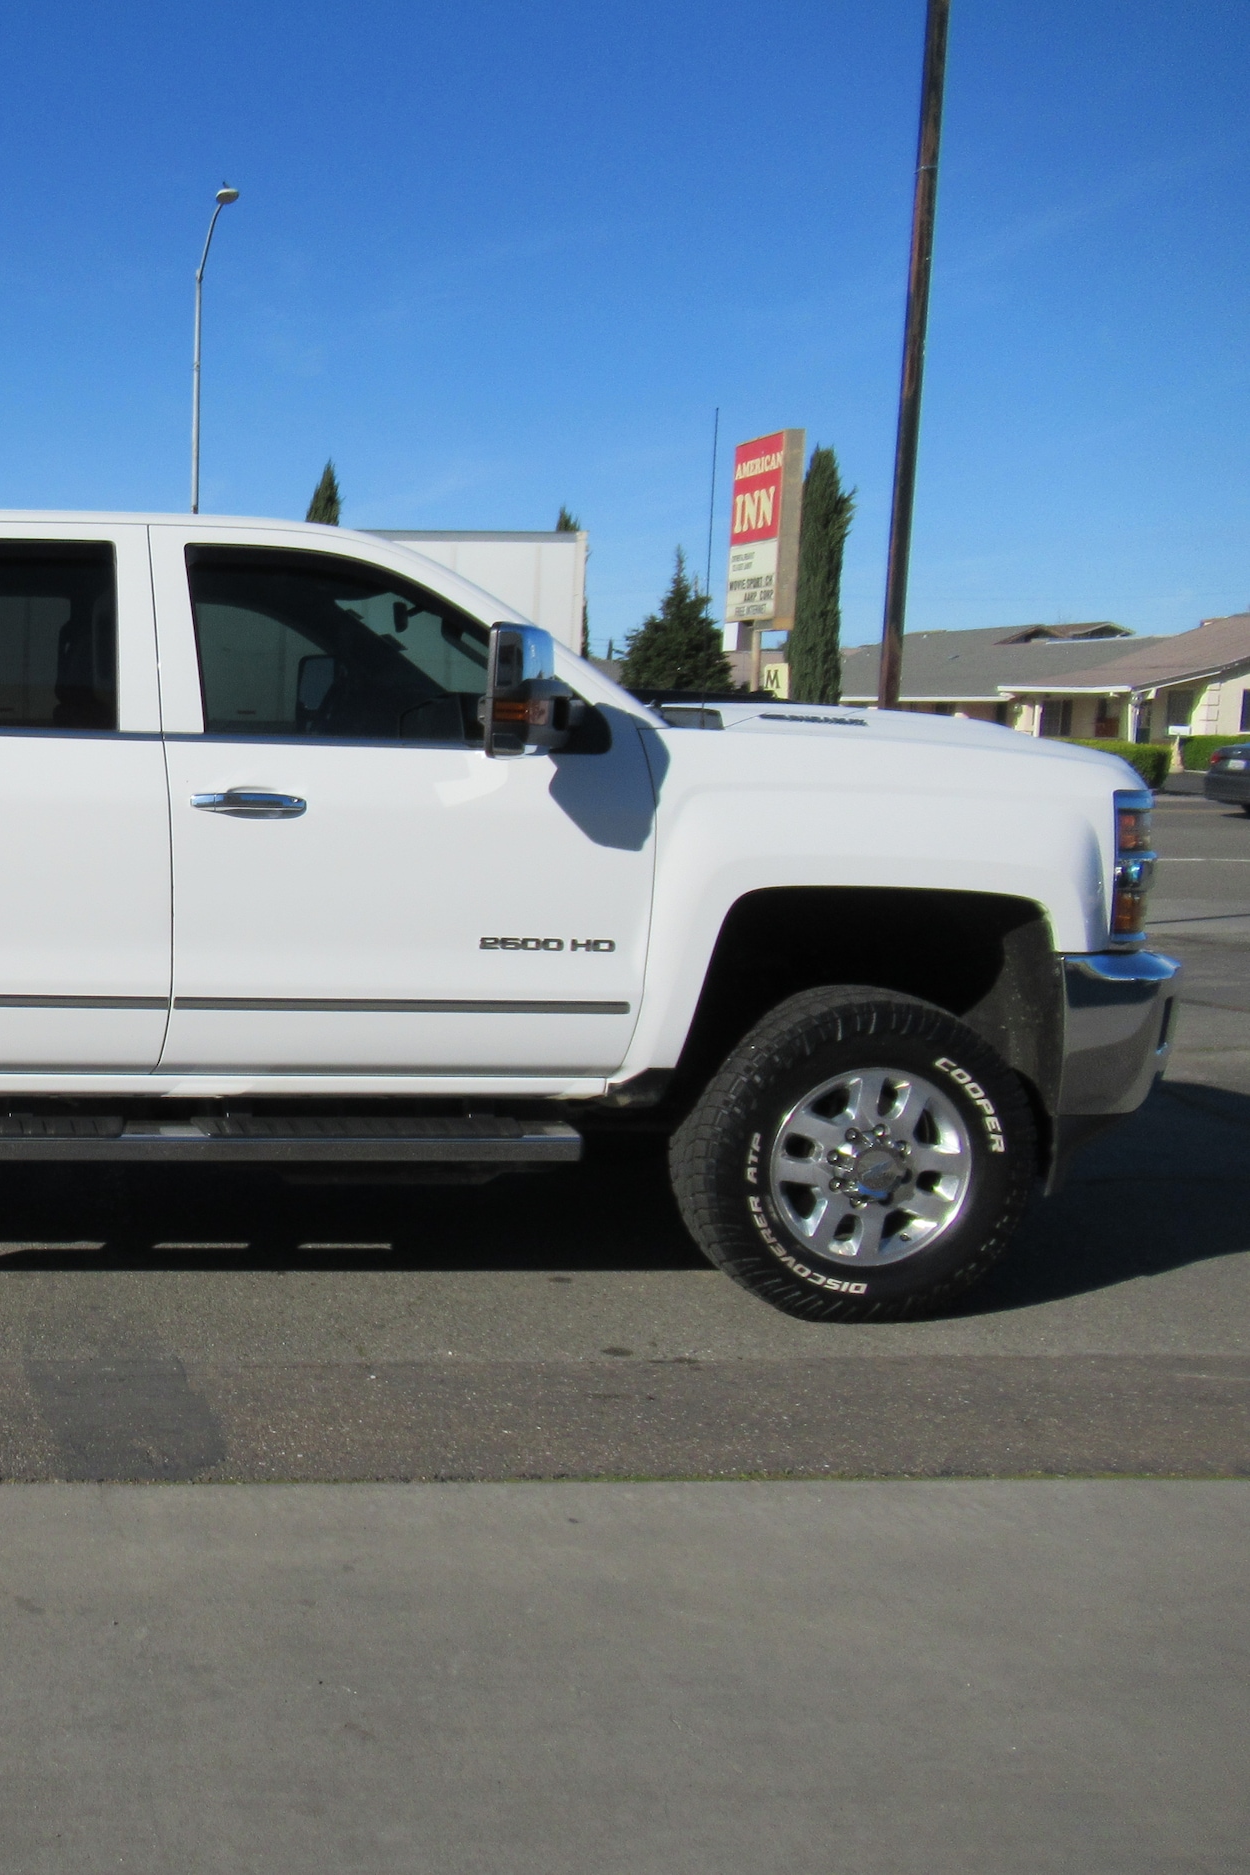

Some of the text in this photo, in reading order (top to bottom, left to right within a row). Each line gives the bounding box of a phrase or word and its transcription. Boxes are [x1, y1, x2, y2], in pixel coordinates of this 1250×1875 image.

[735, 450, 784, 480] AMERICAN
[734, 486, 776, 533] INN
[570, 939, 616, 952] HD
[934, 1057, 1007, 1154] COOPER
[745, 1131, 868, 1295] DISCOVERER ATP
